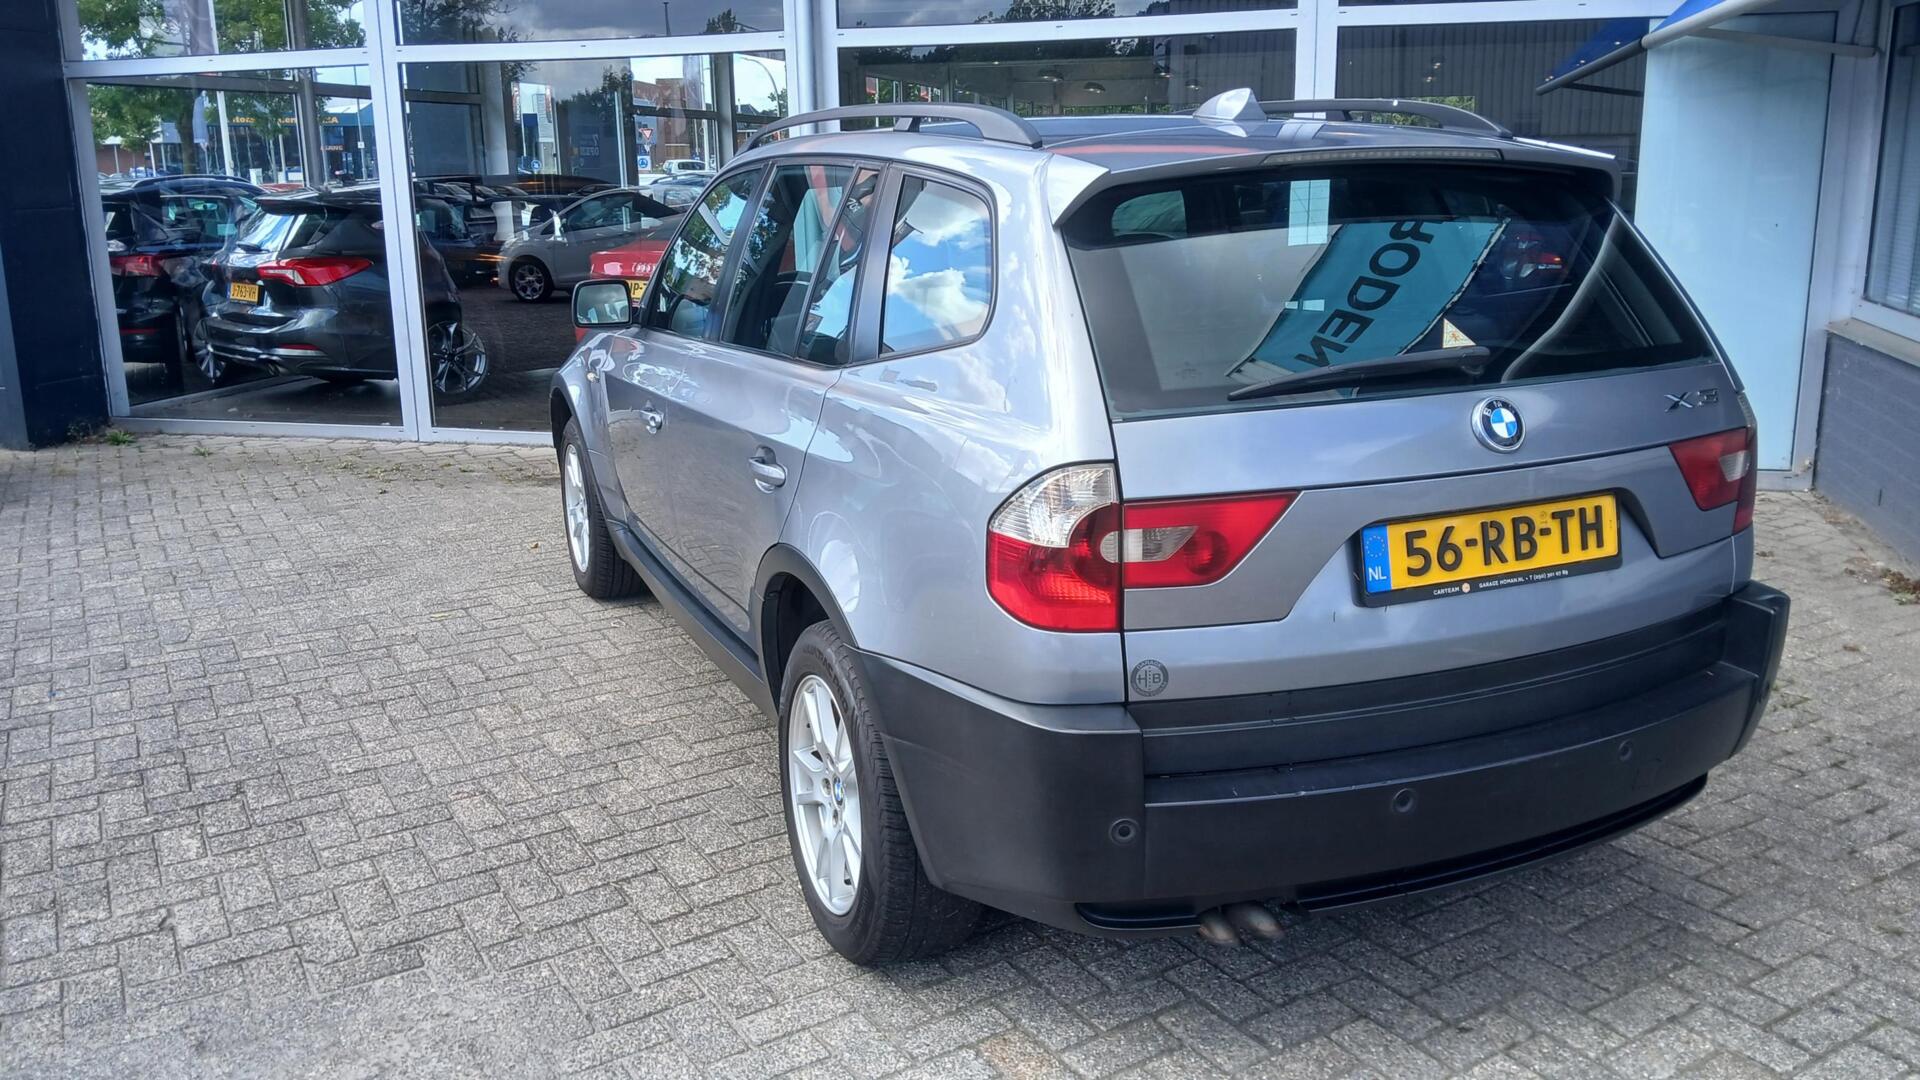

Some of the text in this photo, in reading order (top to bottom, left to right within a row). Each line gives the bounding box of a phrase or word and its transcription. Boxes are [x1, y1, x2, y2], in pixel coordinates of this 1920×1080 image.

[1405, 505, 1604, 577] 56-RB-TH
[1368, 566, 1387, 581] NL
[1479, 580, 1499, 588] GARAGE
[1433, 586, 1460, 595] CARTEAM
